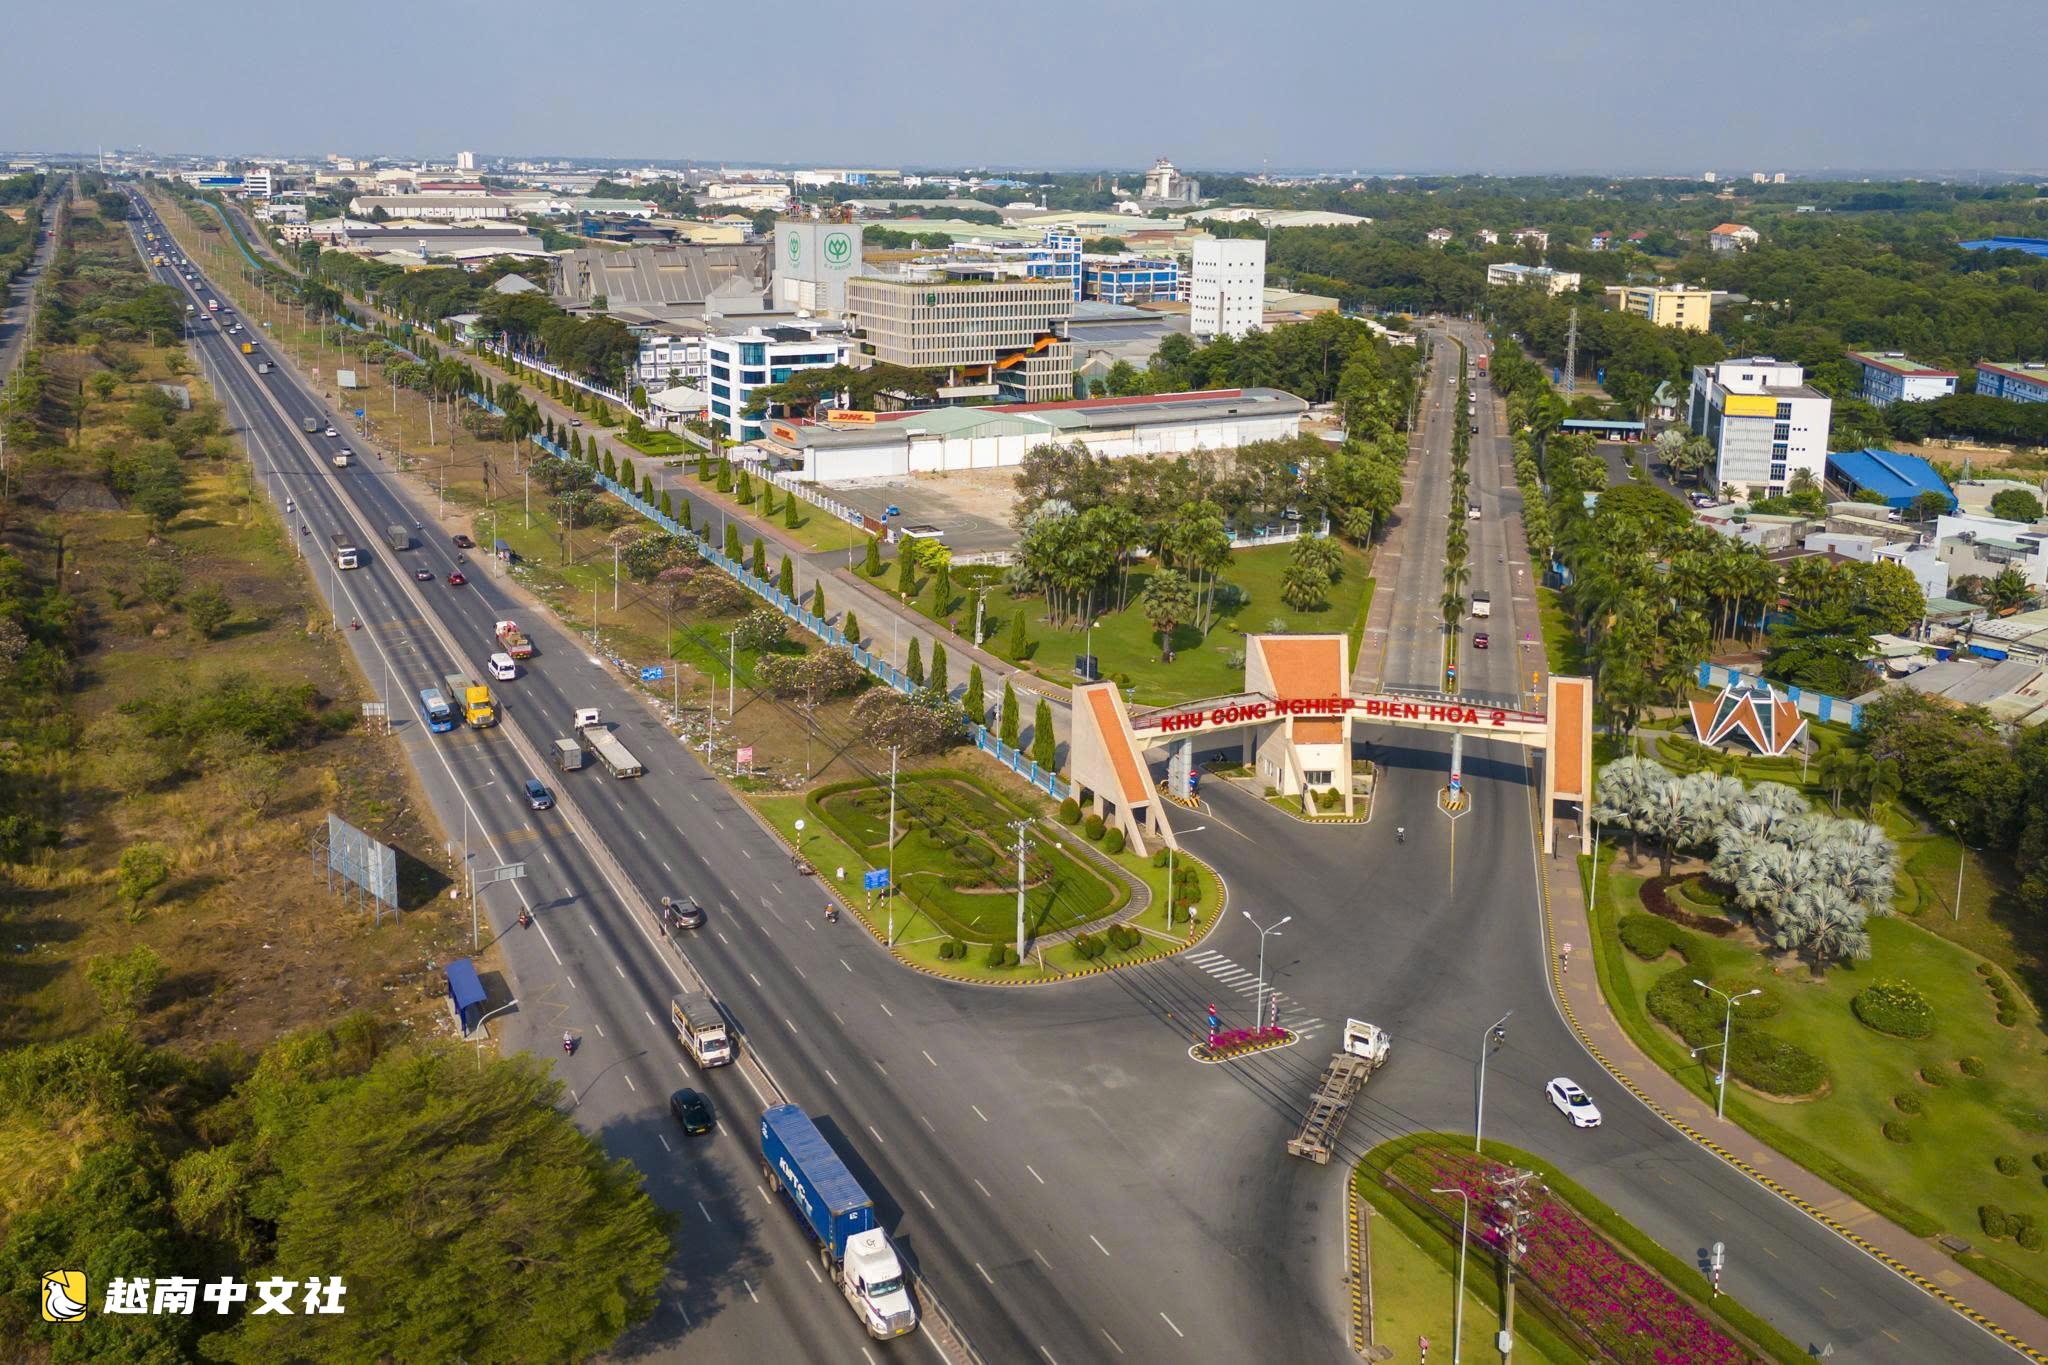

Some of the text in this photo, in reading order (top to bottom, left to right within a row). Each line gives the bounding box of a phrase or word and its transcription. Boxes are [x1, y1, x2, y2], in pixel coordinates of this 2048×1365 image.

[1161, 709, 1203, 732] KHU
[1211, 702, 1267, 724] CÔNG
[1366, 695, 1419, 719] BIÊN
[1490, 711, 1506, 726] 2
